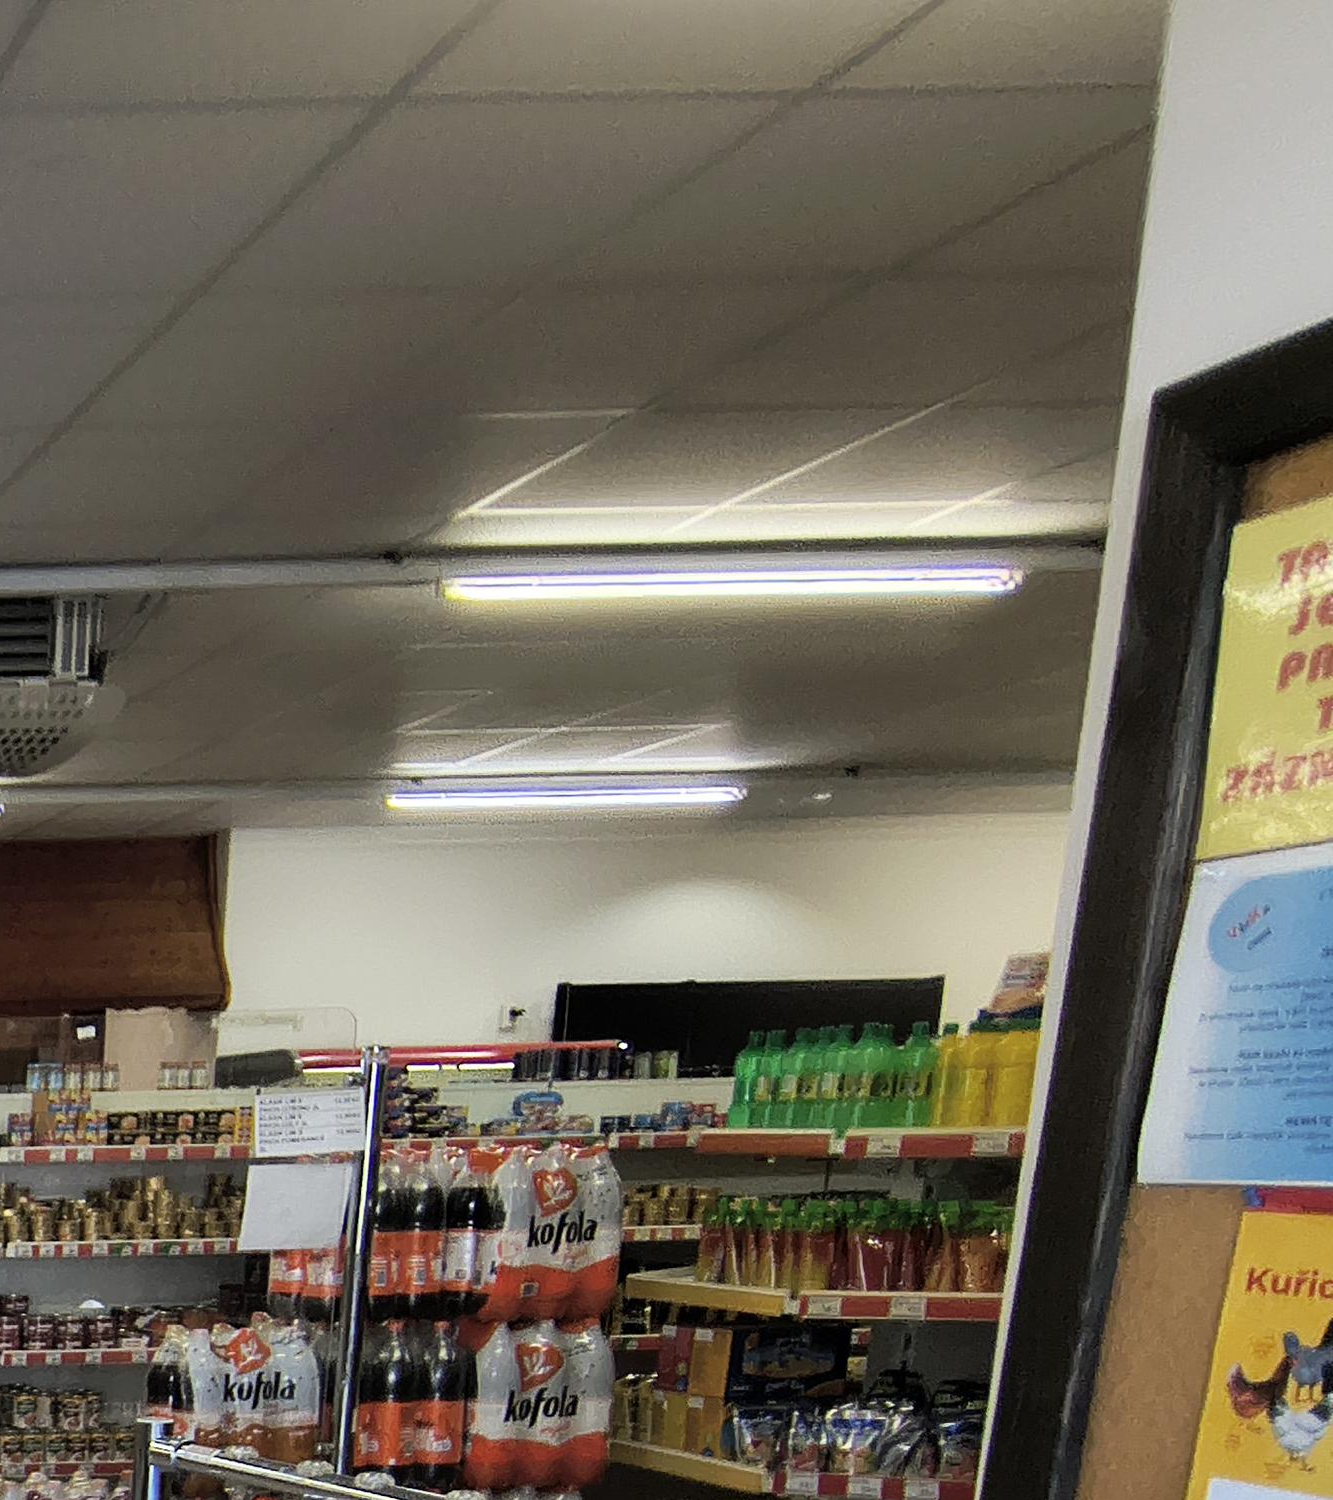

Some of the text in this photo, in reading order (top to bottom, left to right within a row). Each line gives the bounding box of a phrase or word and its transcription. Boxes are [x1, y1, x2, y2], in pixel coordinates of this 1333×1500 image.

[527, 1211, 598, 1254] kofola
[223, 1371, 295, 1410] kofola
[503, 1386, 579, 1429] kofola
